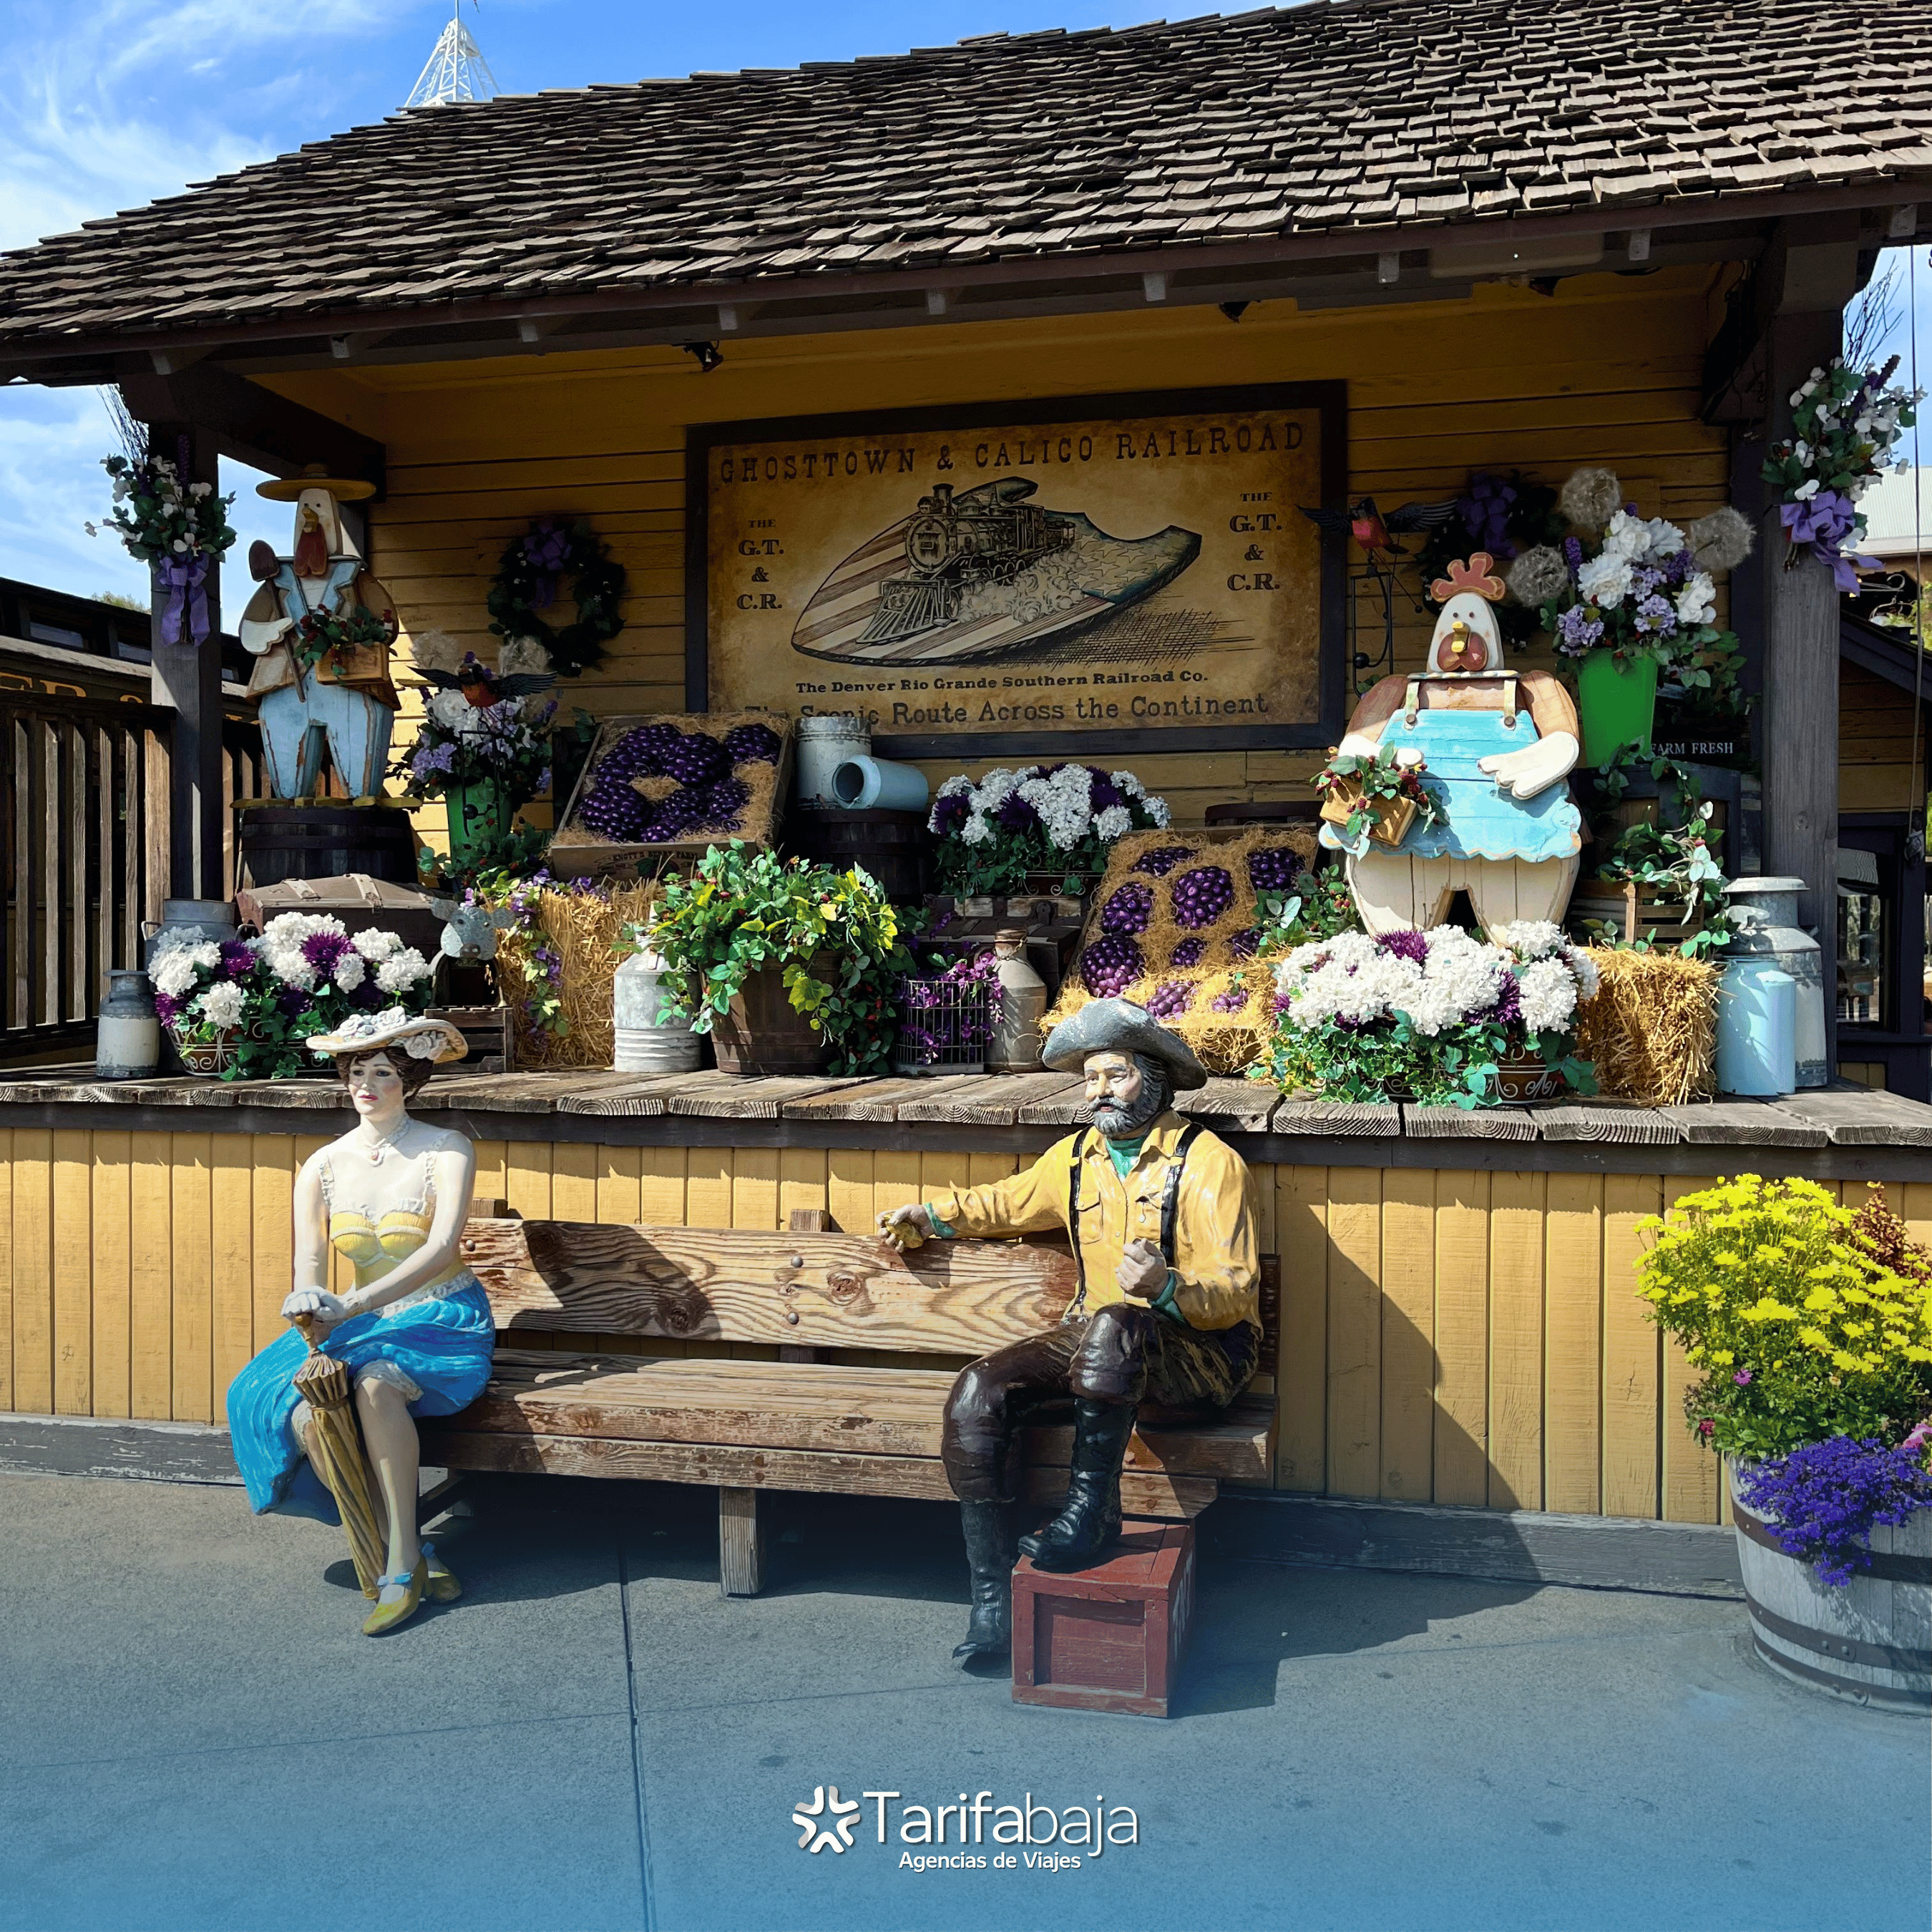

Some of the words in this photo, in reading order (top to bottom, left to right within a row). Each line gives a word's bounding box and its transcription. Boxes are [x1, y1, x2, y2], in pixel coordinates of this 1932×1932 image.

[721, 448, 915, 483] GHOSTTOWN
[937, 444, 954, 471] &
[975, 435, 1093, 467] CALICO
[1116, 422, 1303, 460] RAILROAD
[1240, 492, 1273, 502] THE
[748, 519, 776, 528] THE
[1229, 513, 1282, 532] G.T.
[738, 540, 784, 556] G.T.
[1244, 544, 1264, 561] &
[751, 567, 769, 582] &
[1227, 573, 1281, 591] C.R.
[737, 594, 782, 610] C.R.
[796, 683, 826, 693] The
[831, 681, 895, 693] Denver
[901, 679, 929, 691] Rio
[934, 678, 997, 690] Grande
[1002, 673, 1088, 688] Southern
[1093, 670, 1174, 685] Railroad
[1180, 670, 1208, 683] Co.
[892, 701, 967, 724] Route
[979, 700, 1064, 721] Across
[1075, 697, 1118, 719] the
[1131, 693, 1269, 718] Continent
[1692, 742, 1734, 754] FRESH
